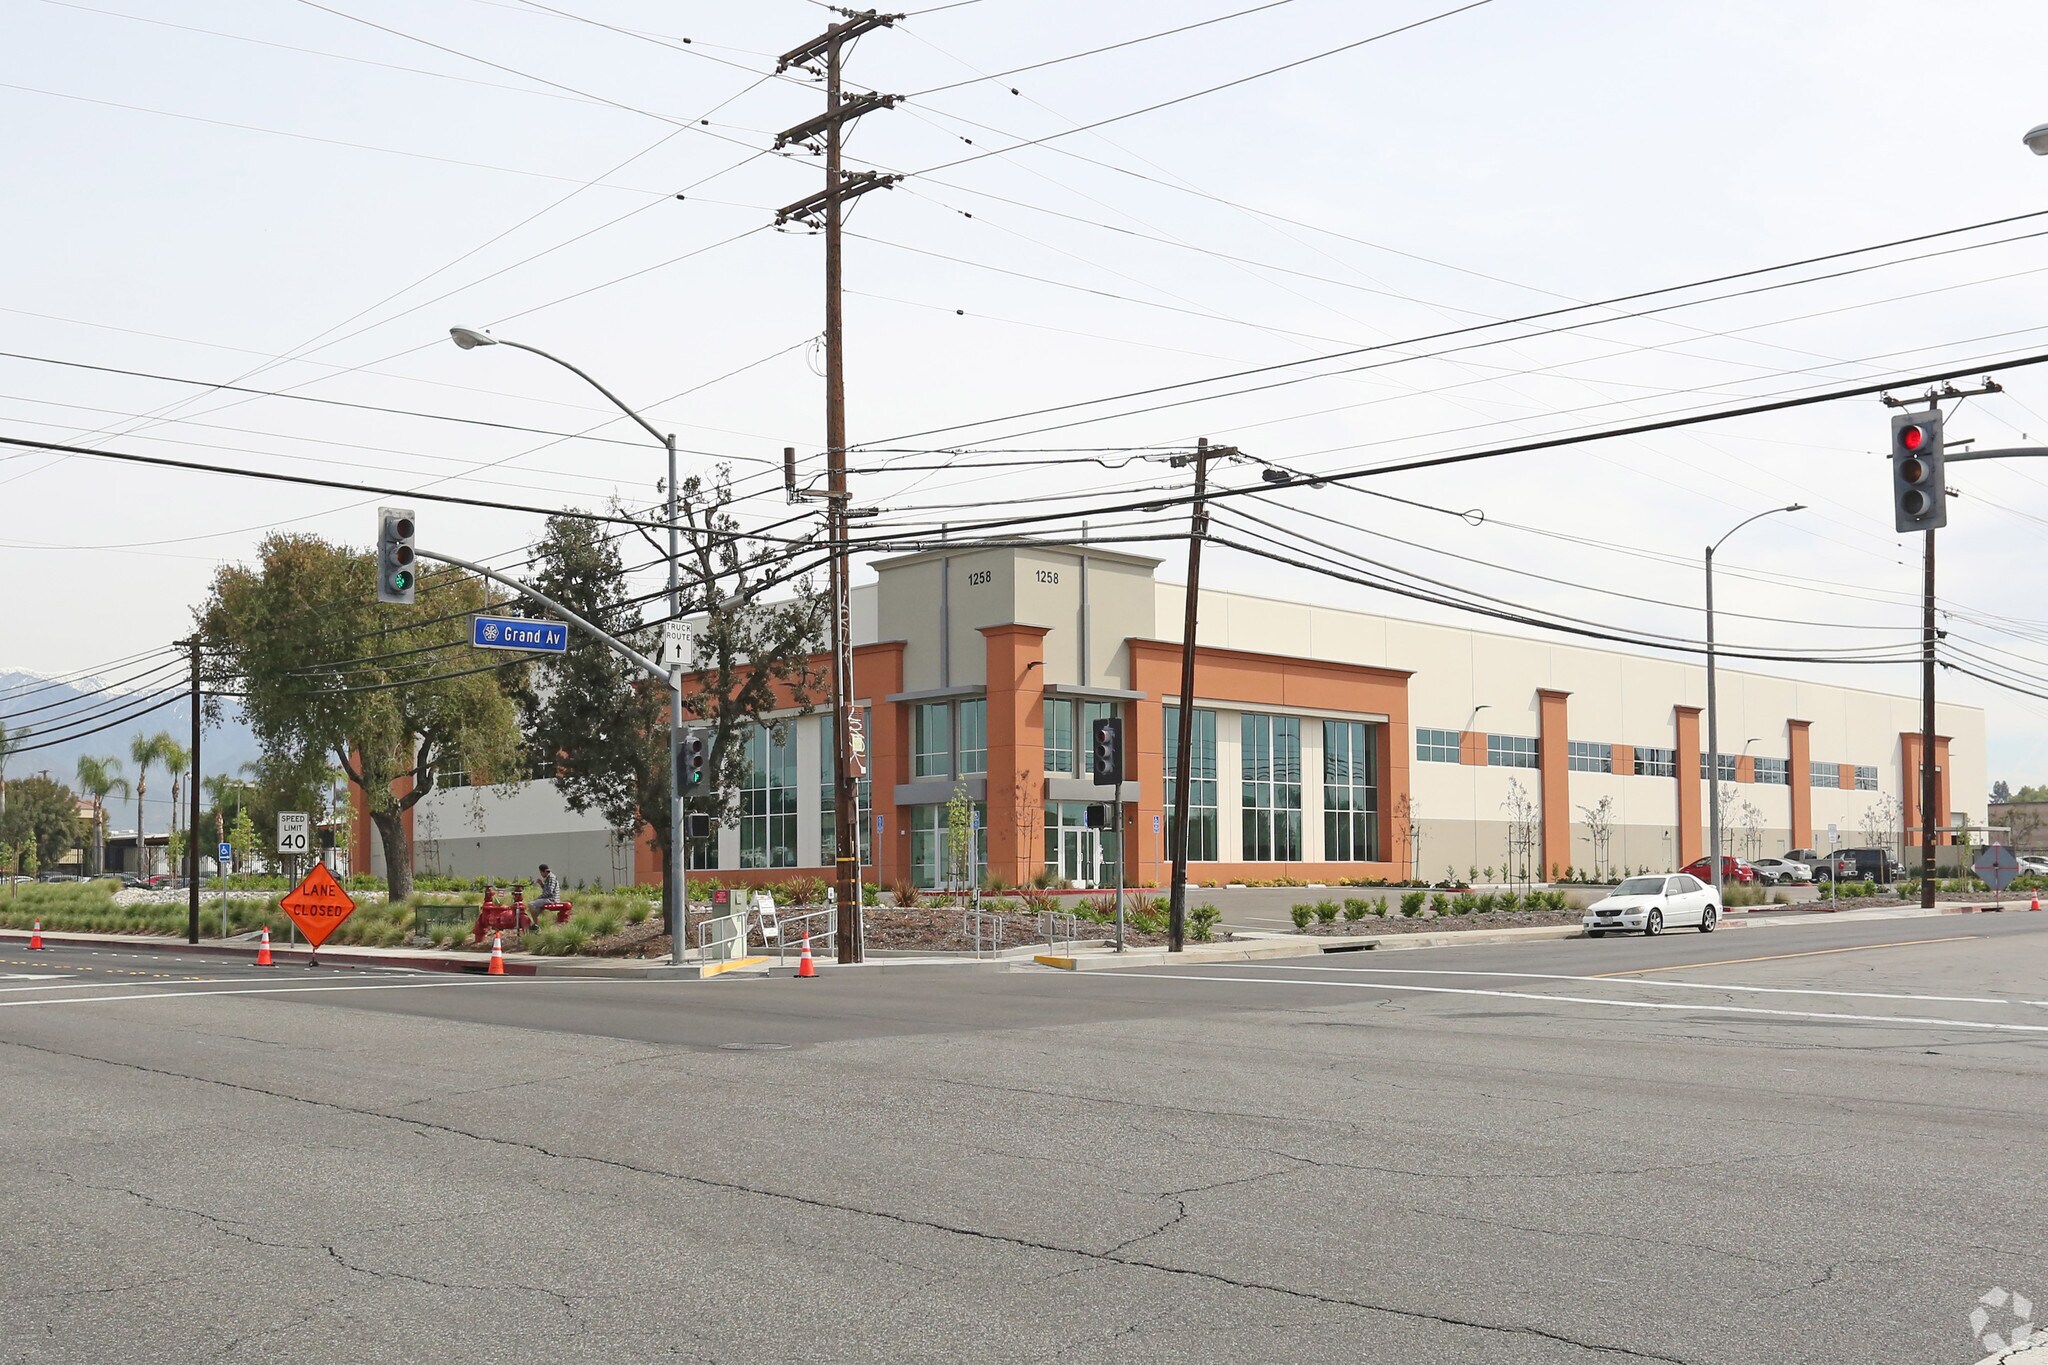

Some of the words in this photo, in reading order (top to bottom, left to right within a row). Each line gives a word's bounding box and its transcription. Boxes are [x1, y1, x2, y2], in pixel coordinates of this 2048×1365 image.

[968, 570, 991, 586] 1258
[1035, 570, 1059, 584] 1258
[666, 622, 691, 631] TRUCK
[504, 626, 541, 643] Grand
[545, 630, 560, 644] Av
[666, 632, 691, 641] ROUTE
[281, 834, 306, 849] 40
[303, 885, 336, 897] LANE
[293, 904, 342, 917] CLOSED
